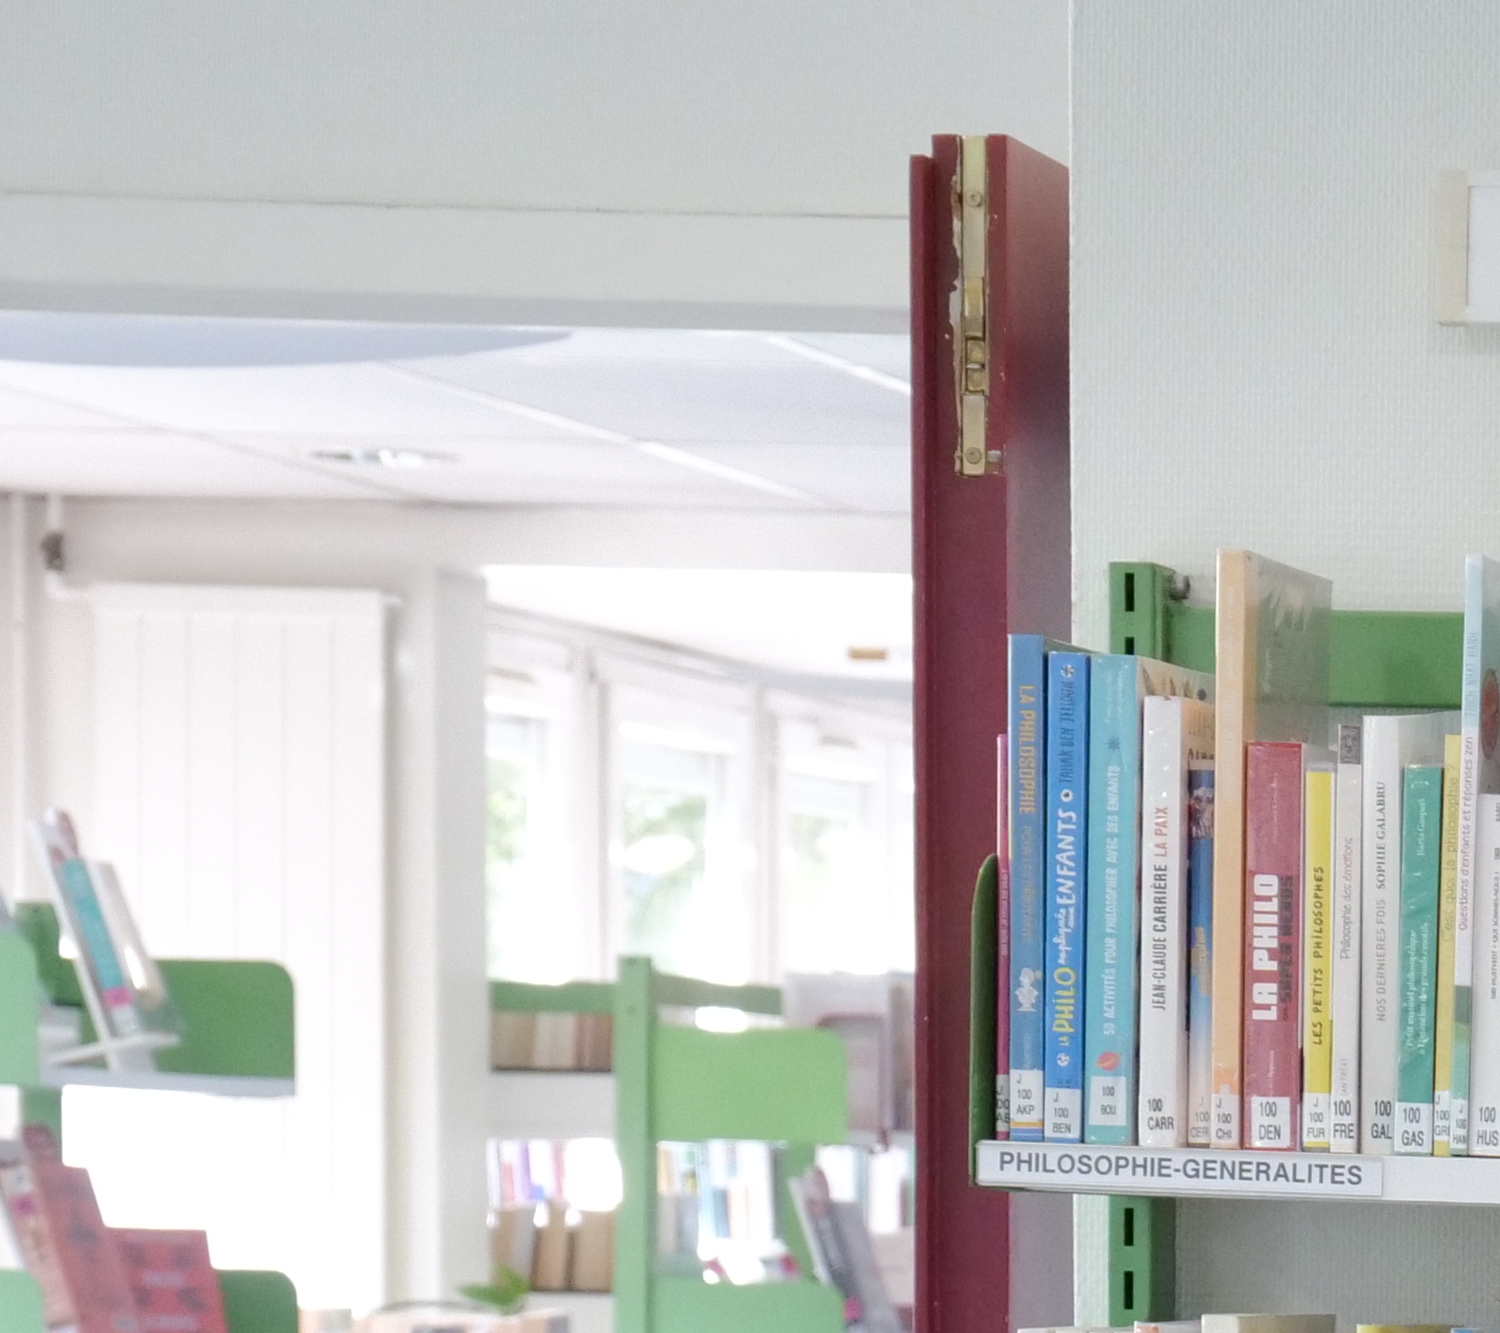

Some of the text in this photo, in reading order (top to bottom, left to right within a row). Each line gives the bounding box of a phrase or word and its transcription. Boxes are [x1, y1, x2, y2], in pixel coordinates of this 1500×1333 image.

[1252, 873, 1281, 964] PHILO
[1251, 980, 1279, 1021] LA
[1258, 1101, 1277, 1117] 100
[1258, 1123, 1281, 1140] DEN
[998, 1152, 1363, 1187] PHILOSOPHIE-GENERALITES
